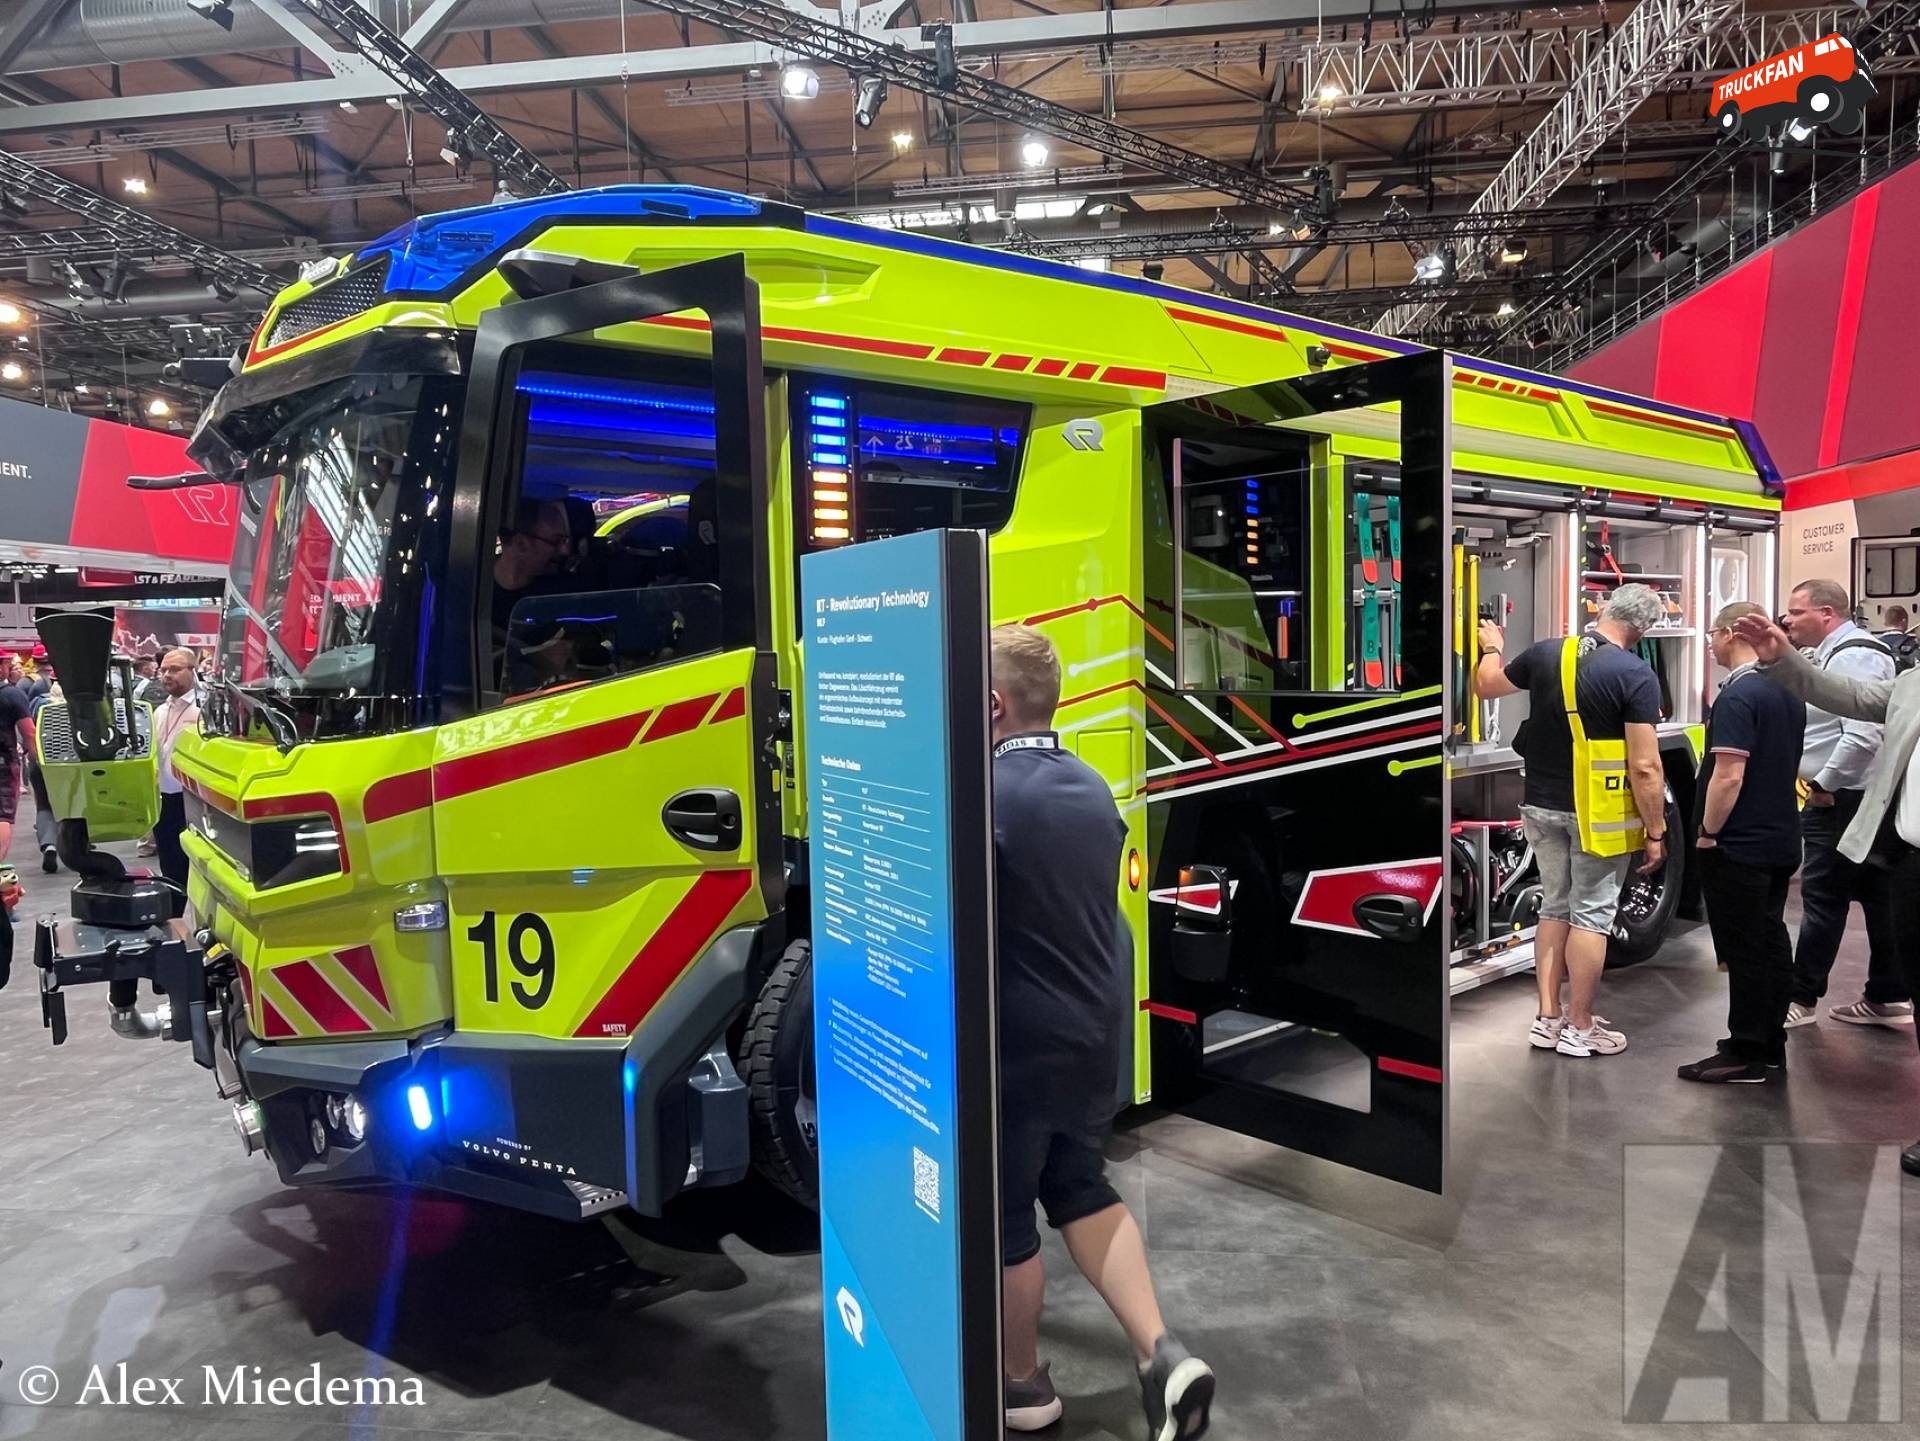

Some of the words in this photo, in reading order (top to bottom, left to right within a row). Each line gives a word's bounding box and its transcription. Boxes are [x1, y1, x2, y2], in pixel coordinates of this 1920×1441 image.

[0, 461, 32, 479] ENT.
[1802, 523, 1846, 539] CUSTOMER
[1802, 541, 1834, 555] SERVICE
[830, 595, 880, 612] Revolutionary
[881, 588, 930, 608] Technology
[467, 911, 555, 1010] 19
[462, 1140, 511, 1161] VOLVO
[519, 1157, 576, 1175] PENTA
